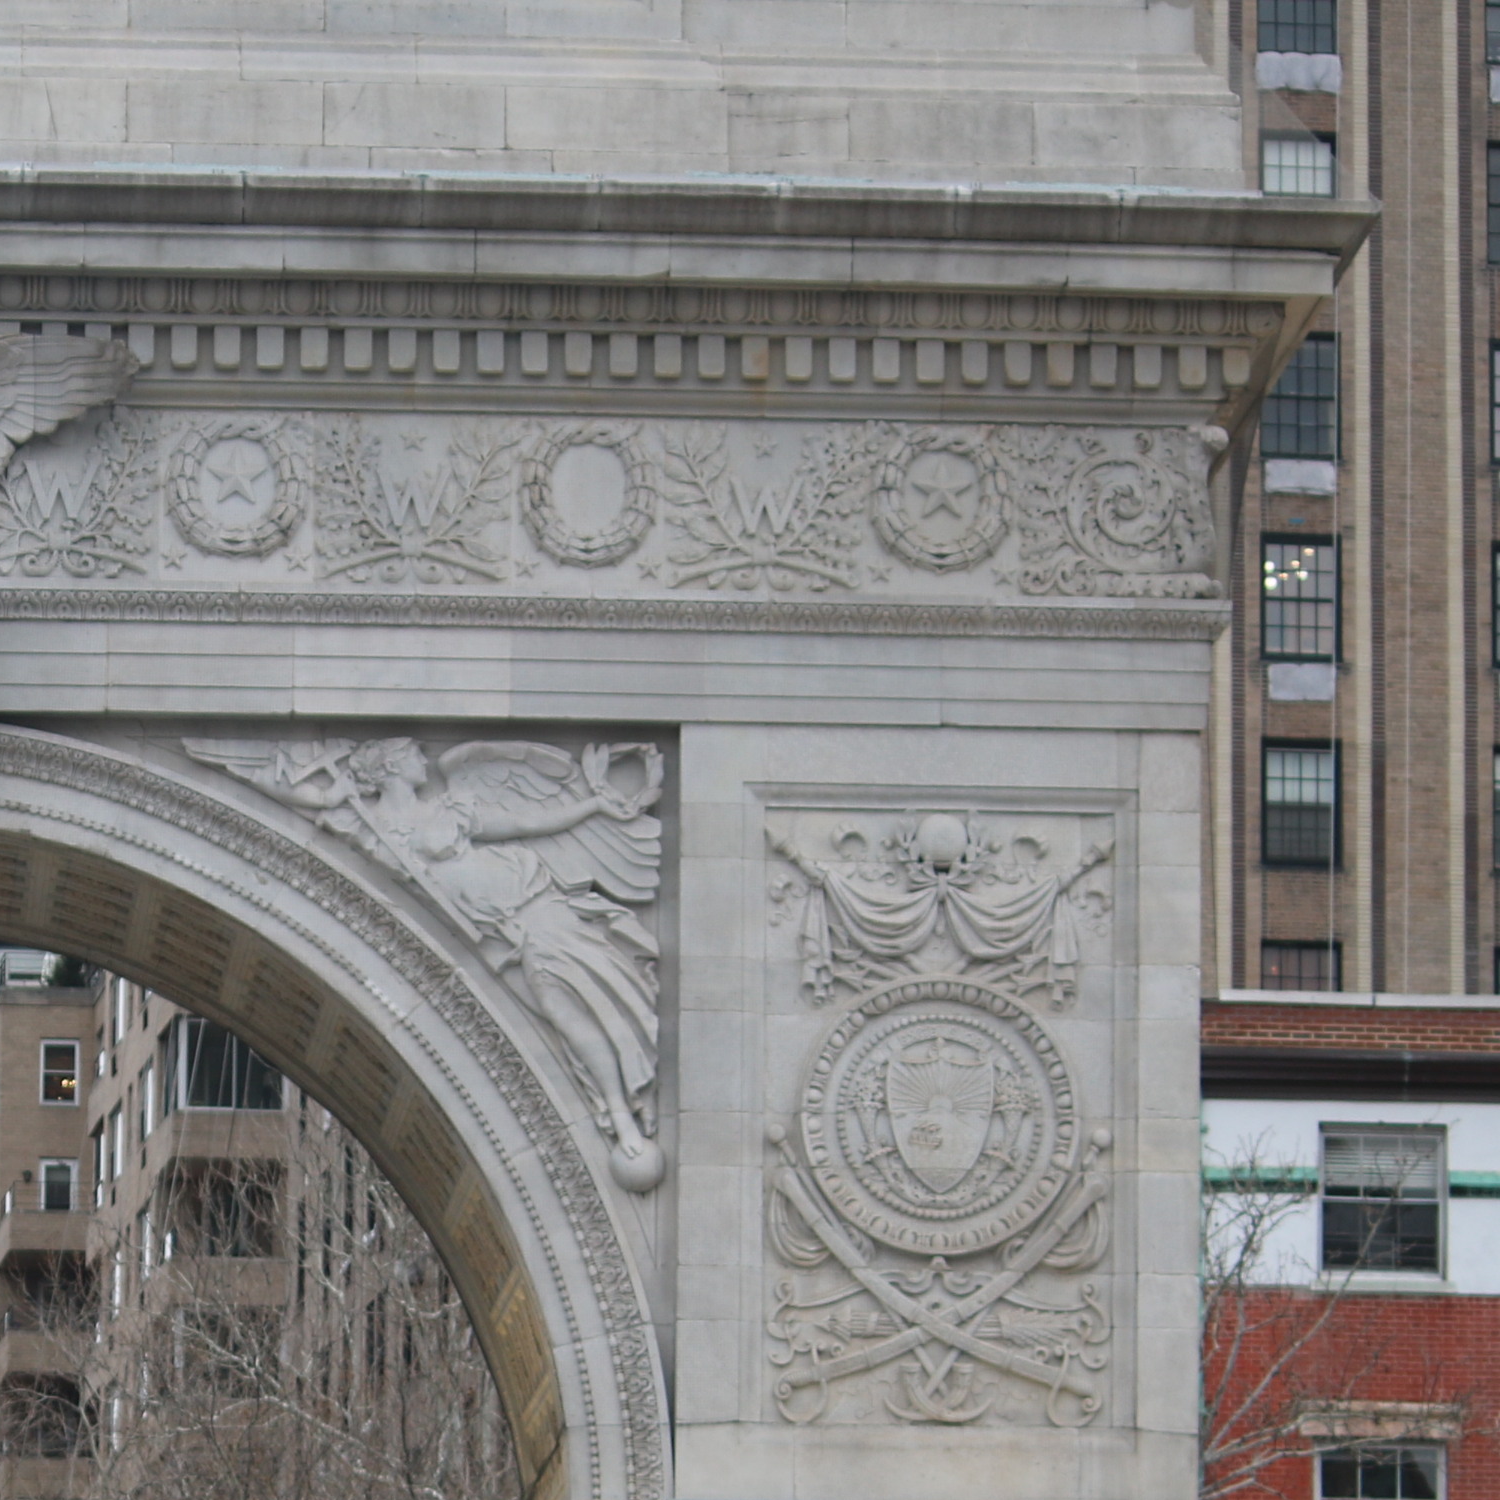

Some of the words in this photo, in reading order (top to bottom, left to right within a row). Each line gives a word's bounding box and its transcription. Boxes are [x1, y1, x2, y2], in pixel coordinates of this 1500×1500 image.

[23, 457, 101, 520] W
[376, 465, 451, 529] W
[728, 479, 801, 535] W
